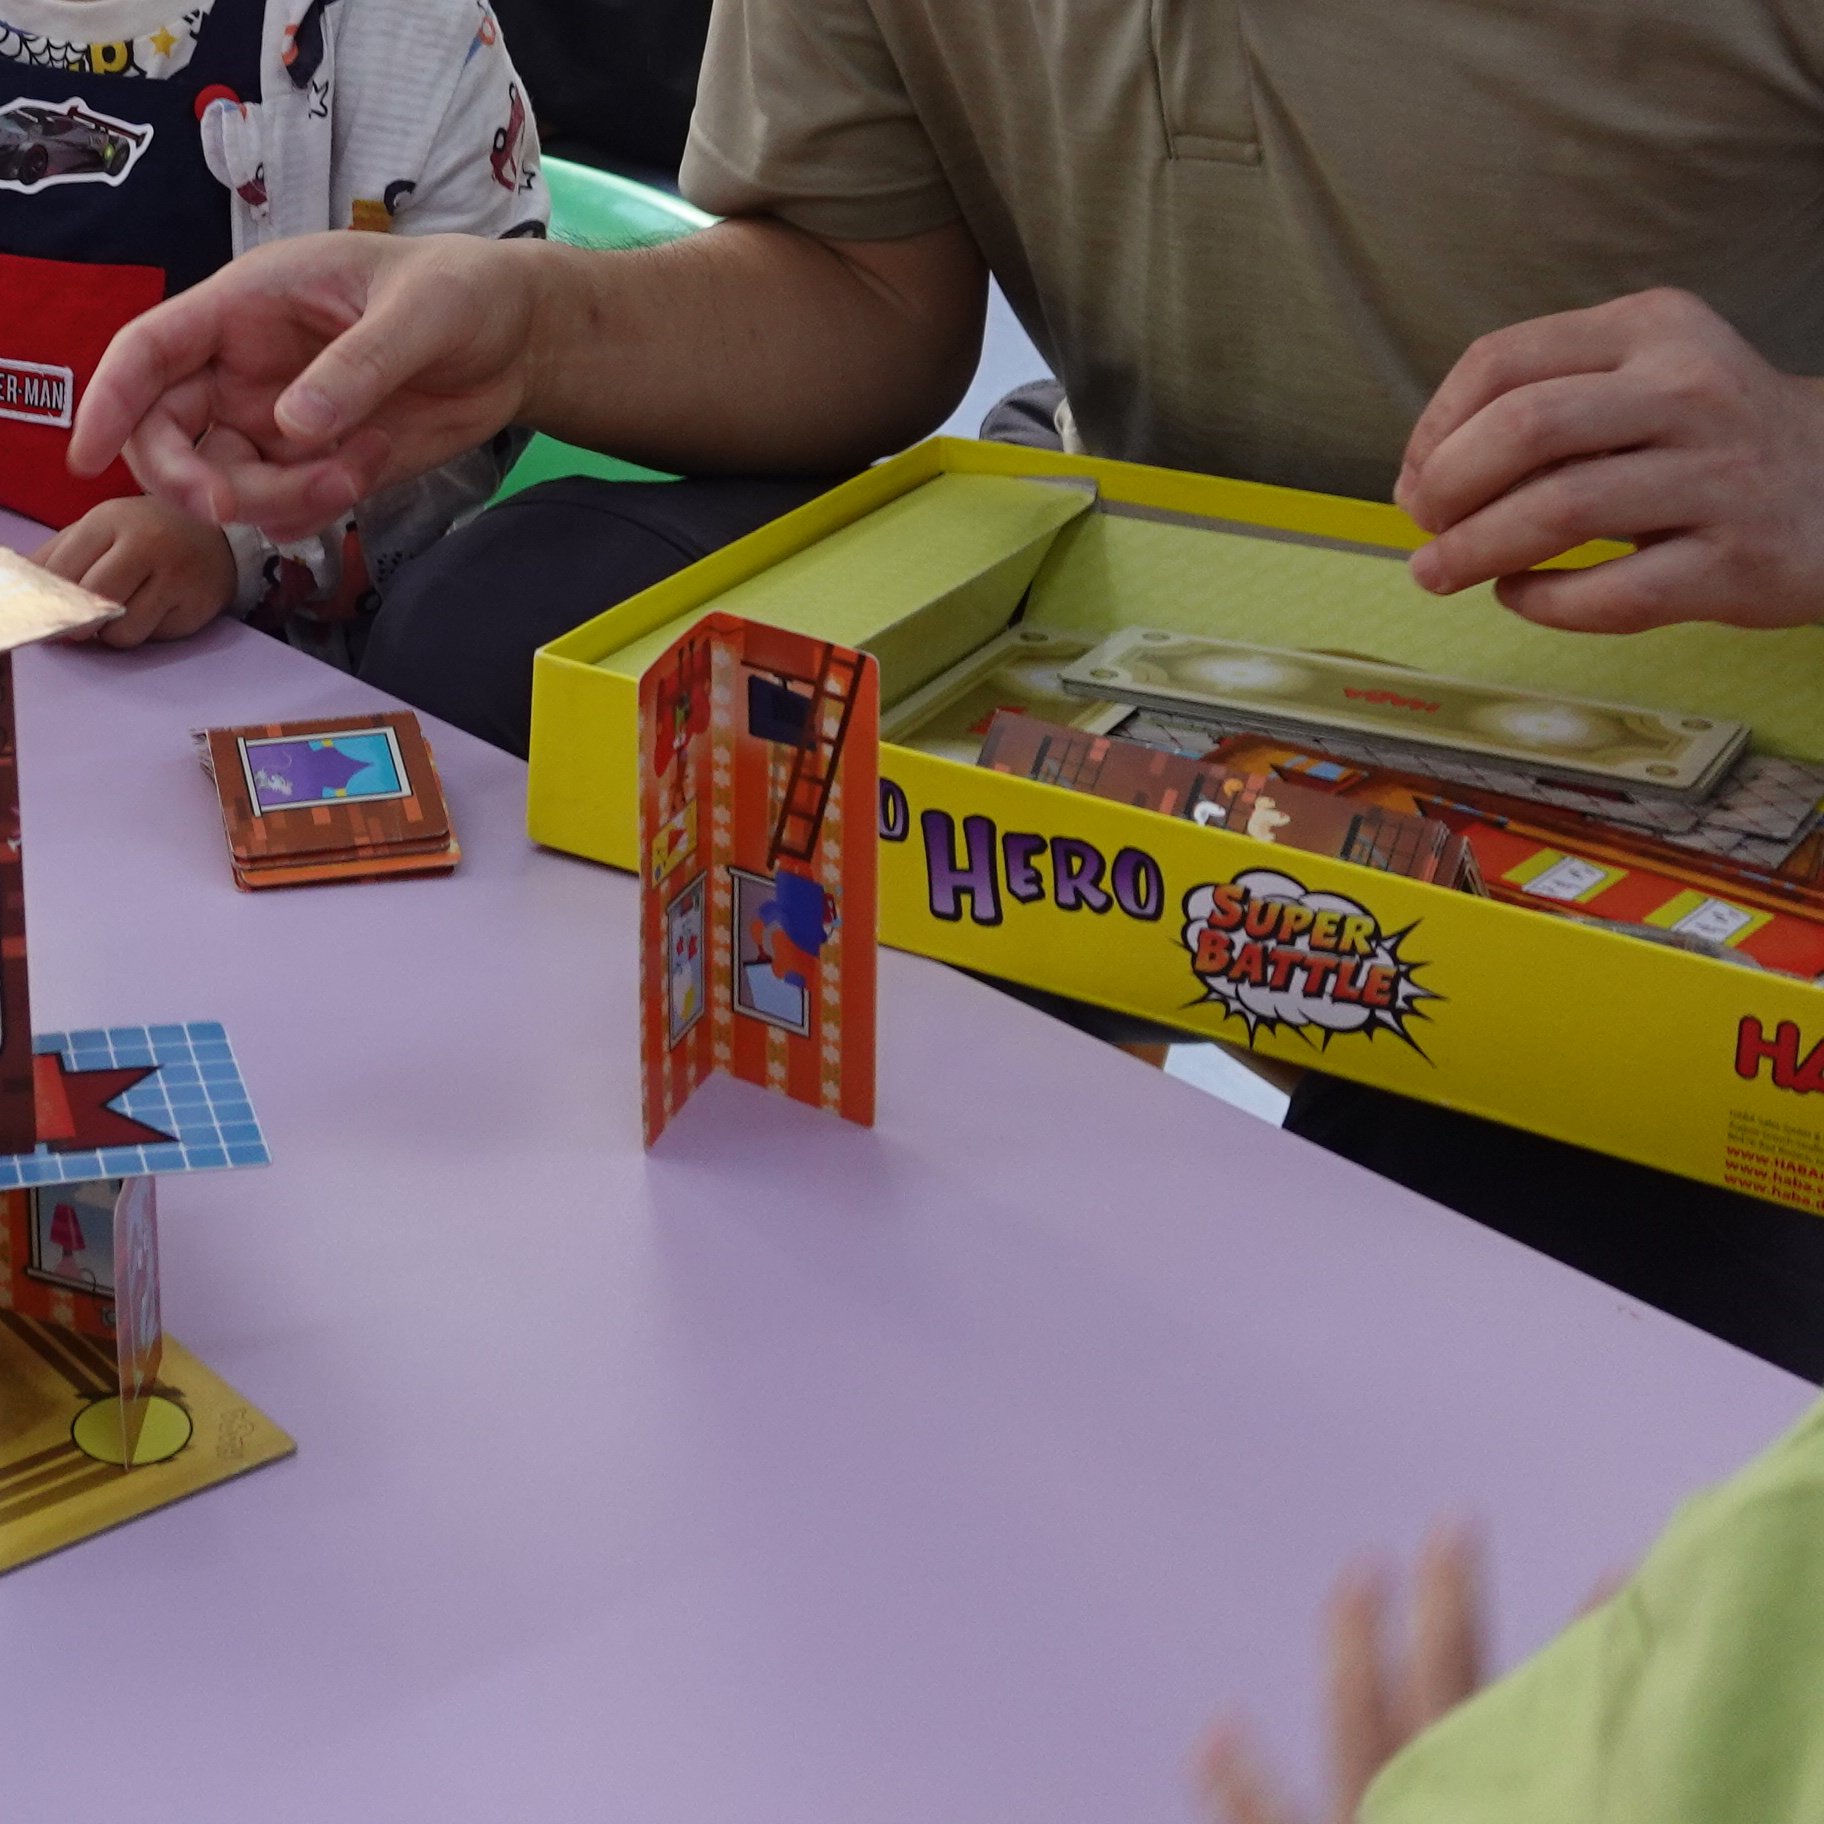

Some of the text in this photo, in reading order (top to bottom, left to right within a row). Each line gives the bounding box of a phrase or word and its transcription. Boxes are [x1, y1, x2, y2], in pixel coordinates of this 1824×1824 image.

[920, 809, 1165, 926] HERO
[1208, 883, 1378, 957] SUPER
[1194, 928, 1399, 1008] BATTLE
